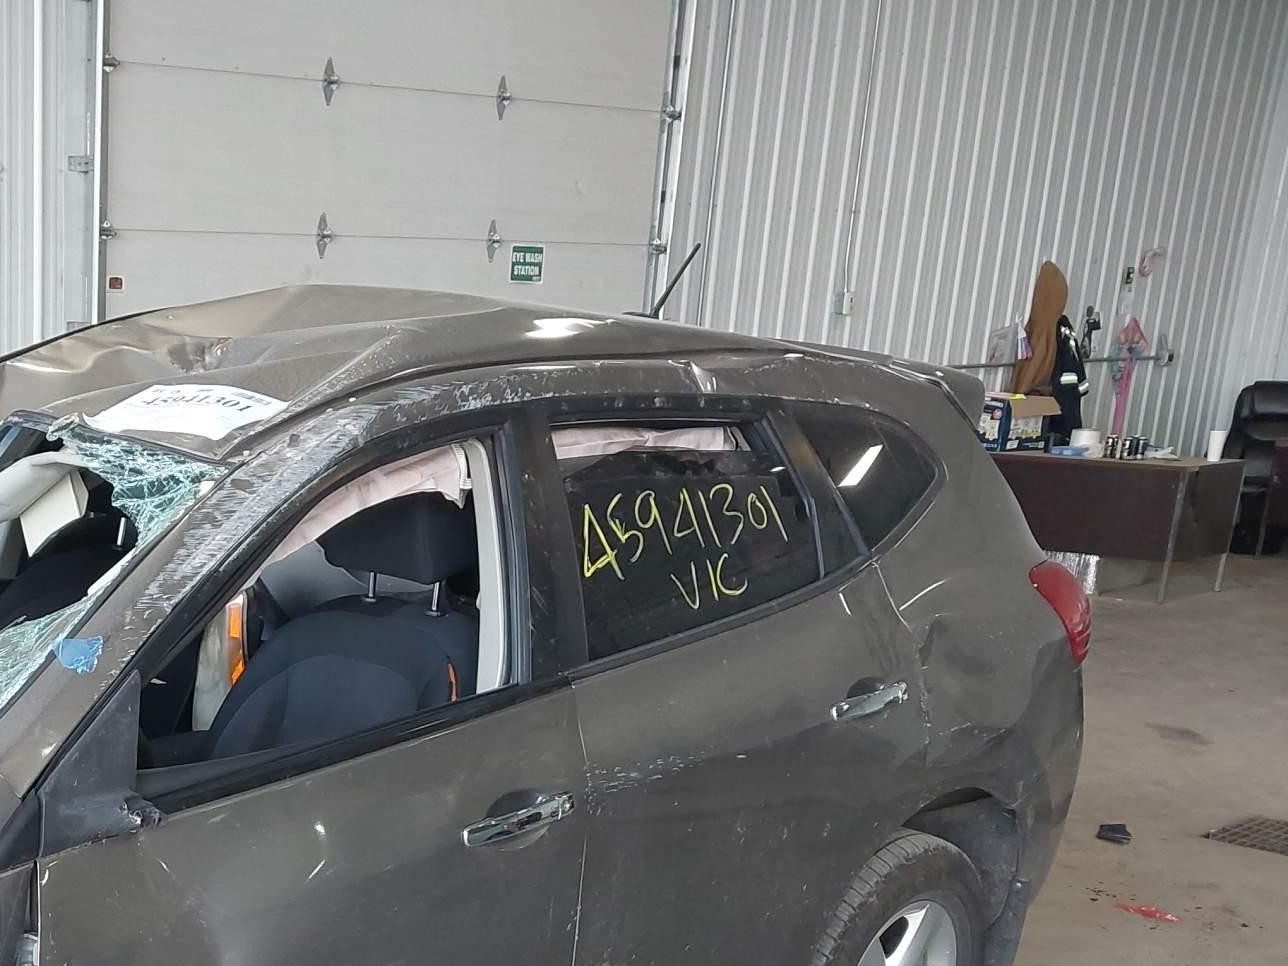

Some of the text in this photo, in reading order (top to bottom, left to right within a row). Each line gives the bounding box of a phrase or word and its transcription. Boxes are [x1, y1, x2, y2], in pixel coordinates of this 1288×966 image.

[513, 253, 542, 262] EYE WASH
[514, 265, 539, 275] STATION
[583, 483, 789, 580] 45941301
[669, 552, 748, 610] VIC
